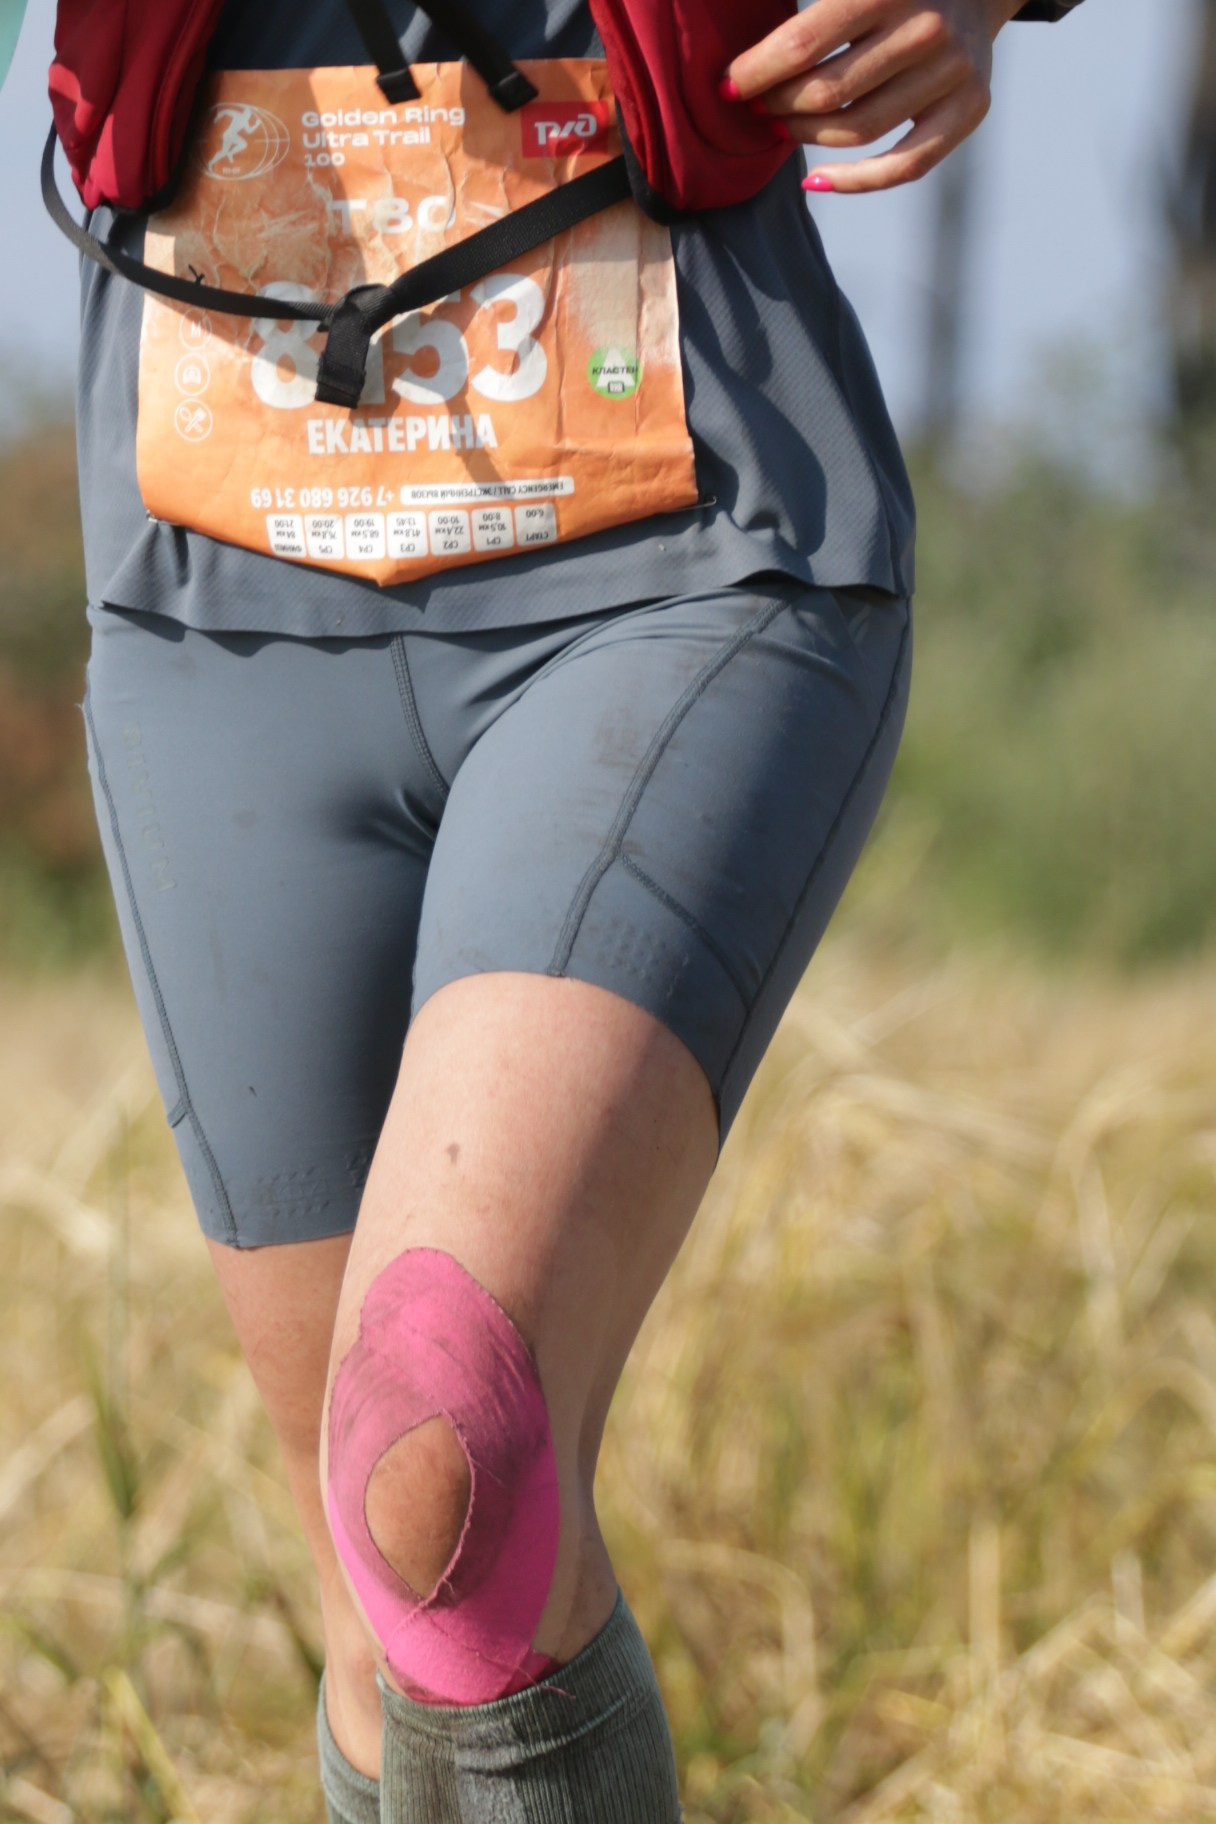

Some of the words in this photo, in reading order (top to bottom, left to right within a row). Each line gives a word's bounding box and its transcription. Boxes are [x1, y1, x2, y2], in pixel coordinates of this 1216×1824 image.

[301, 107, 397, 128] Golden
[404, 106, 466, 126] Ring
[302, 130, 369, 149] Ultra
[372, 126, 431, 145] Trail
[305, 152, 345, 167] 100
[306, 413, 498, 455] ЕКАТЕРИНА
[337, 486, 373, 509] 926
[376, 485, 395, 507] +7
[518, 481, 564, 492] EMERGENCY
[299, 487, 333, 509] 680
